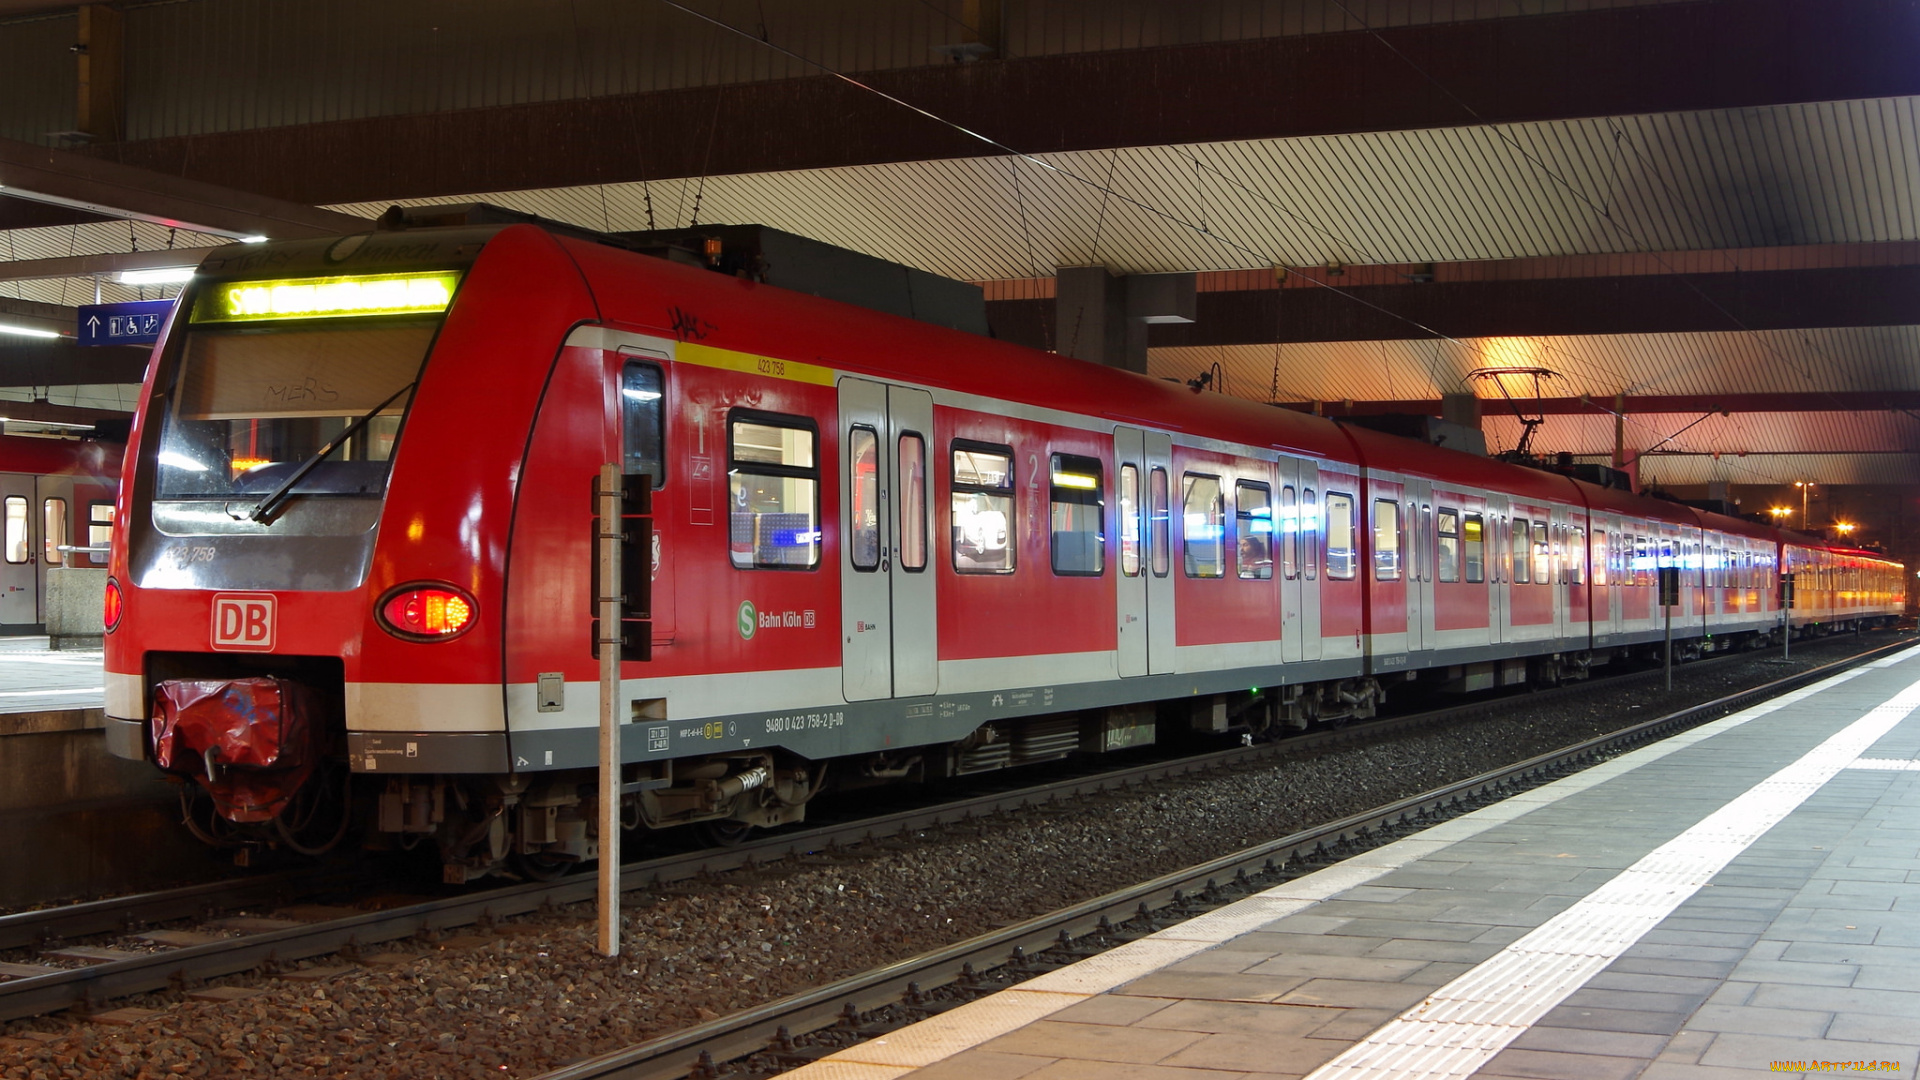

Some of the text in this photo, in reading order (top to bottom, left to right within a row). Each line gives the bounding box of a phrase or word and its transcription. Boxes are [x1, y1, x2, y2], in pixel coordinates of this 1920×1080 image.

[757, 359, 785, 376] 423 758
[1029, 454, 1039, 489] 2
[191, 546, 216, 562] 758
[218, 601, 269, 643] DB
[740, 604, 814, 636] S Bahn Köln DB
[785, 717, 790, 731] 0
[791, 715, 805, 731] 423
[807, 713, 828, 729] 758-2
